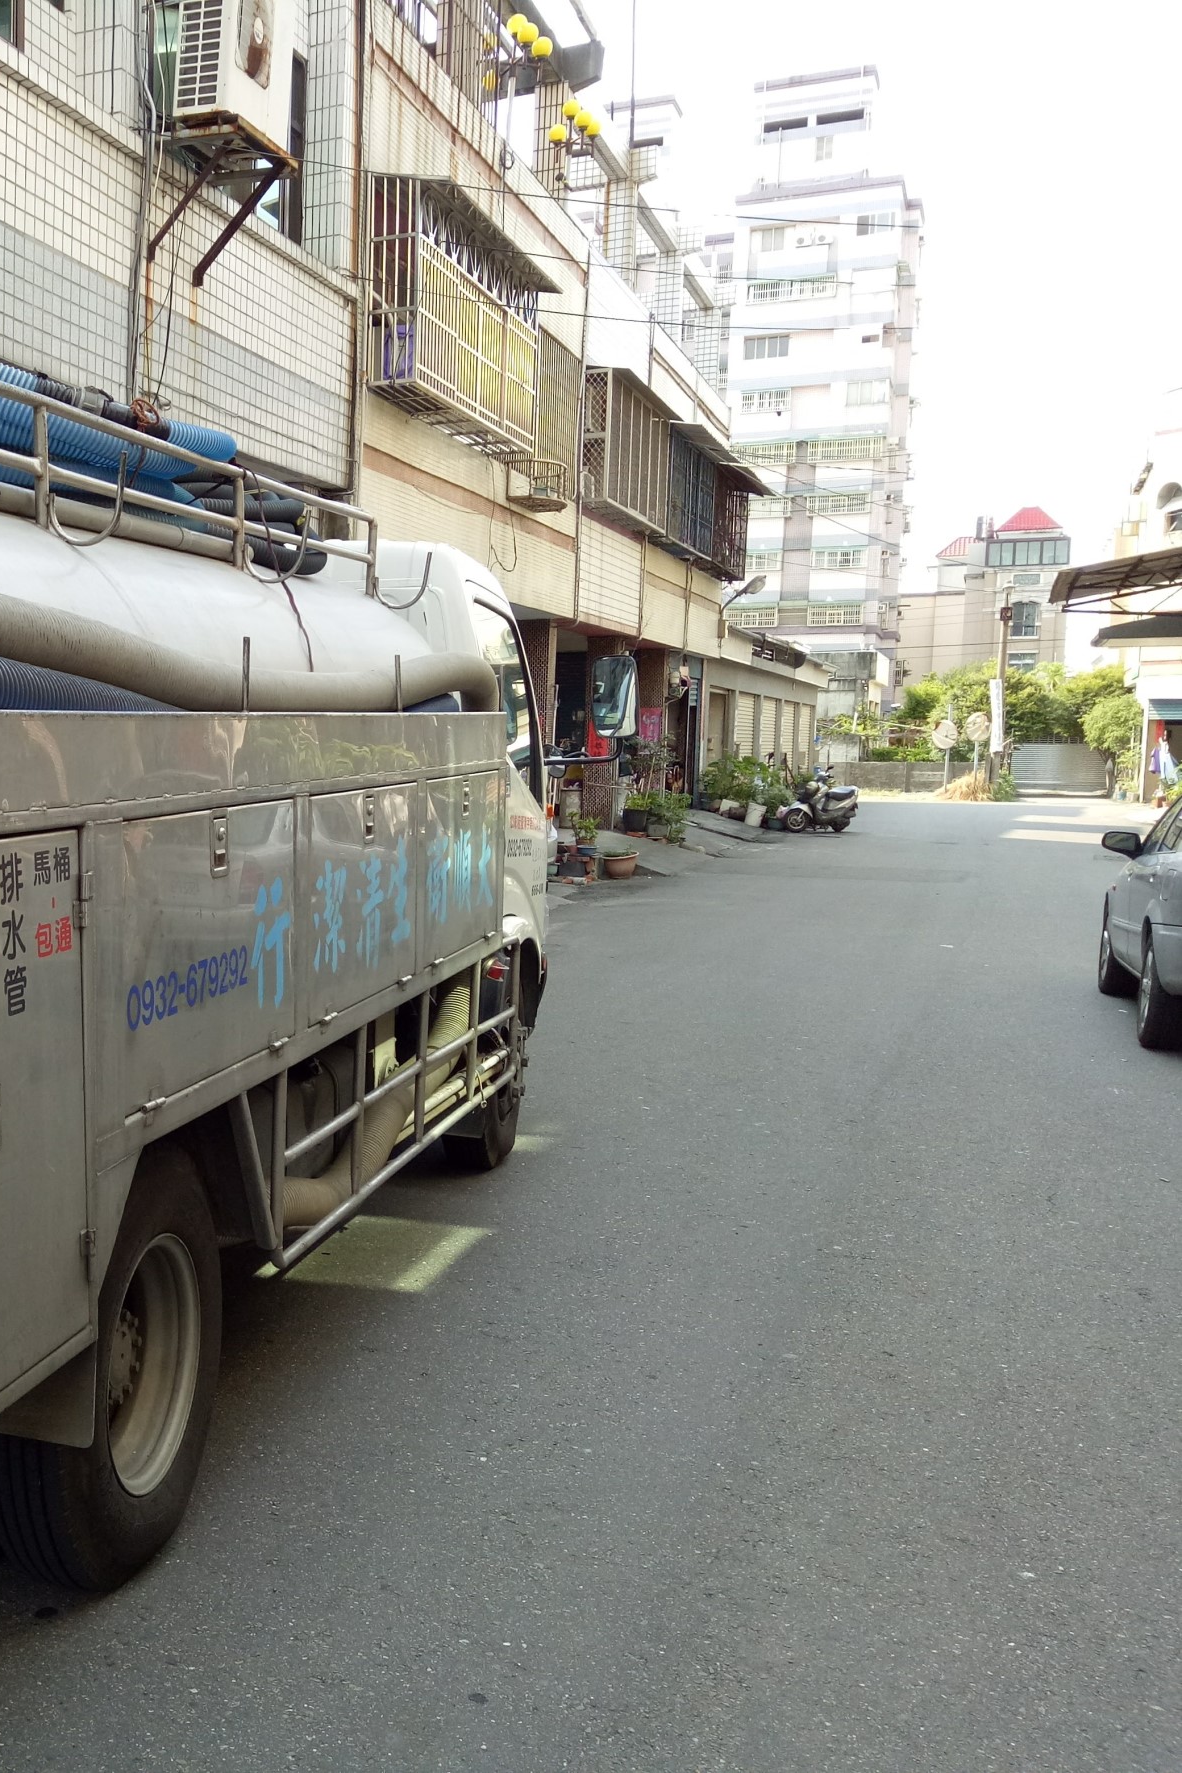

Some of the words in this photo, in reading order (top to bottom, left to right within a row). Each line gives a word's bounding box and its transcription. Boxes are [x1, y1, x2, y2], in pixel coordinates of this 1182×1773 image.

[33, 847, 71, 886] 馬桶
[0, 852, 27, 1016] 排水管
[35, 915, 73, 958] 包通
[127, 945, 248, 1032] 0932-679292
